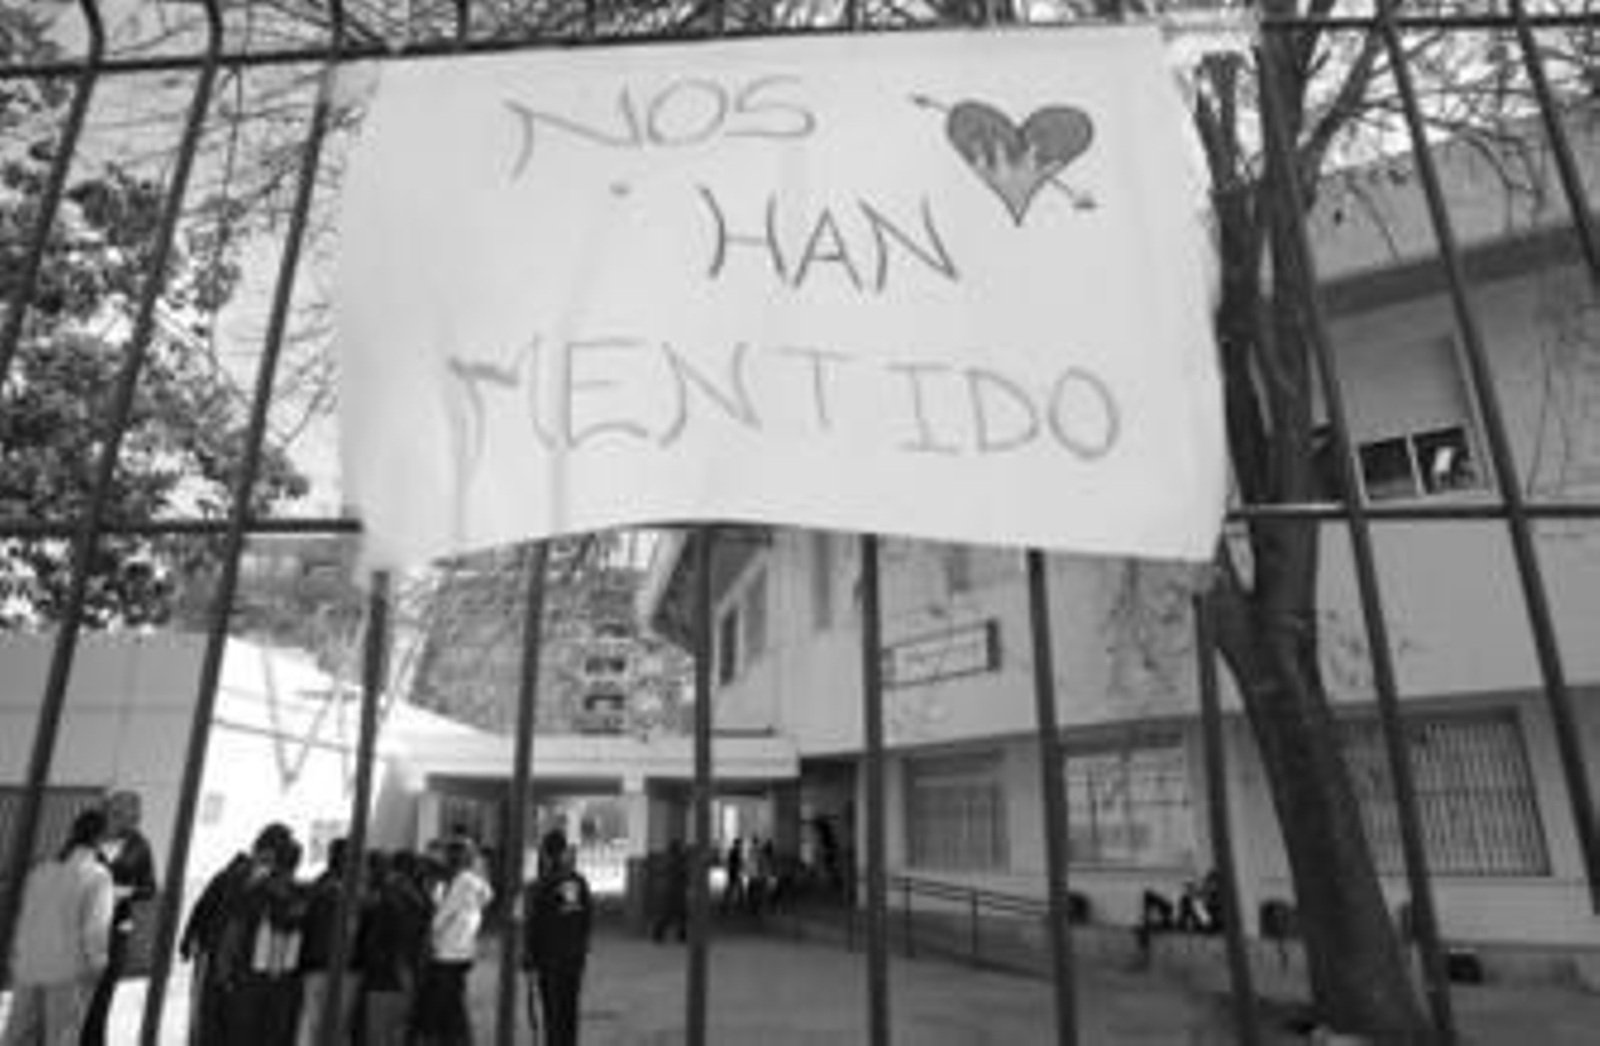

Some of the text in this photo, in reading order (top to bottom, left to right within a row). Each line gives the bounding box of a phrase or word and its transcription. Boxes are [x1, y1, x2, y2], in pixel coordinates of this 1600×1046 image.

[502, 75, 816, 179] NOS
[697, 185, 959, 292] HAN
[448, 333, 1121, 460] MENTIDO
